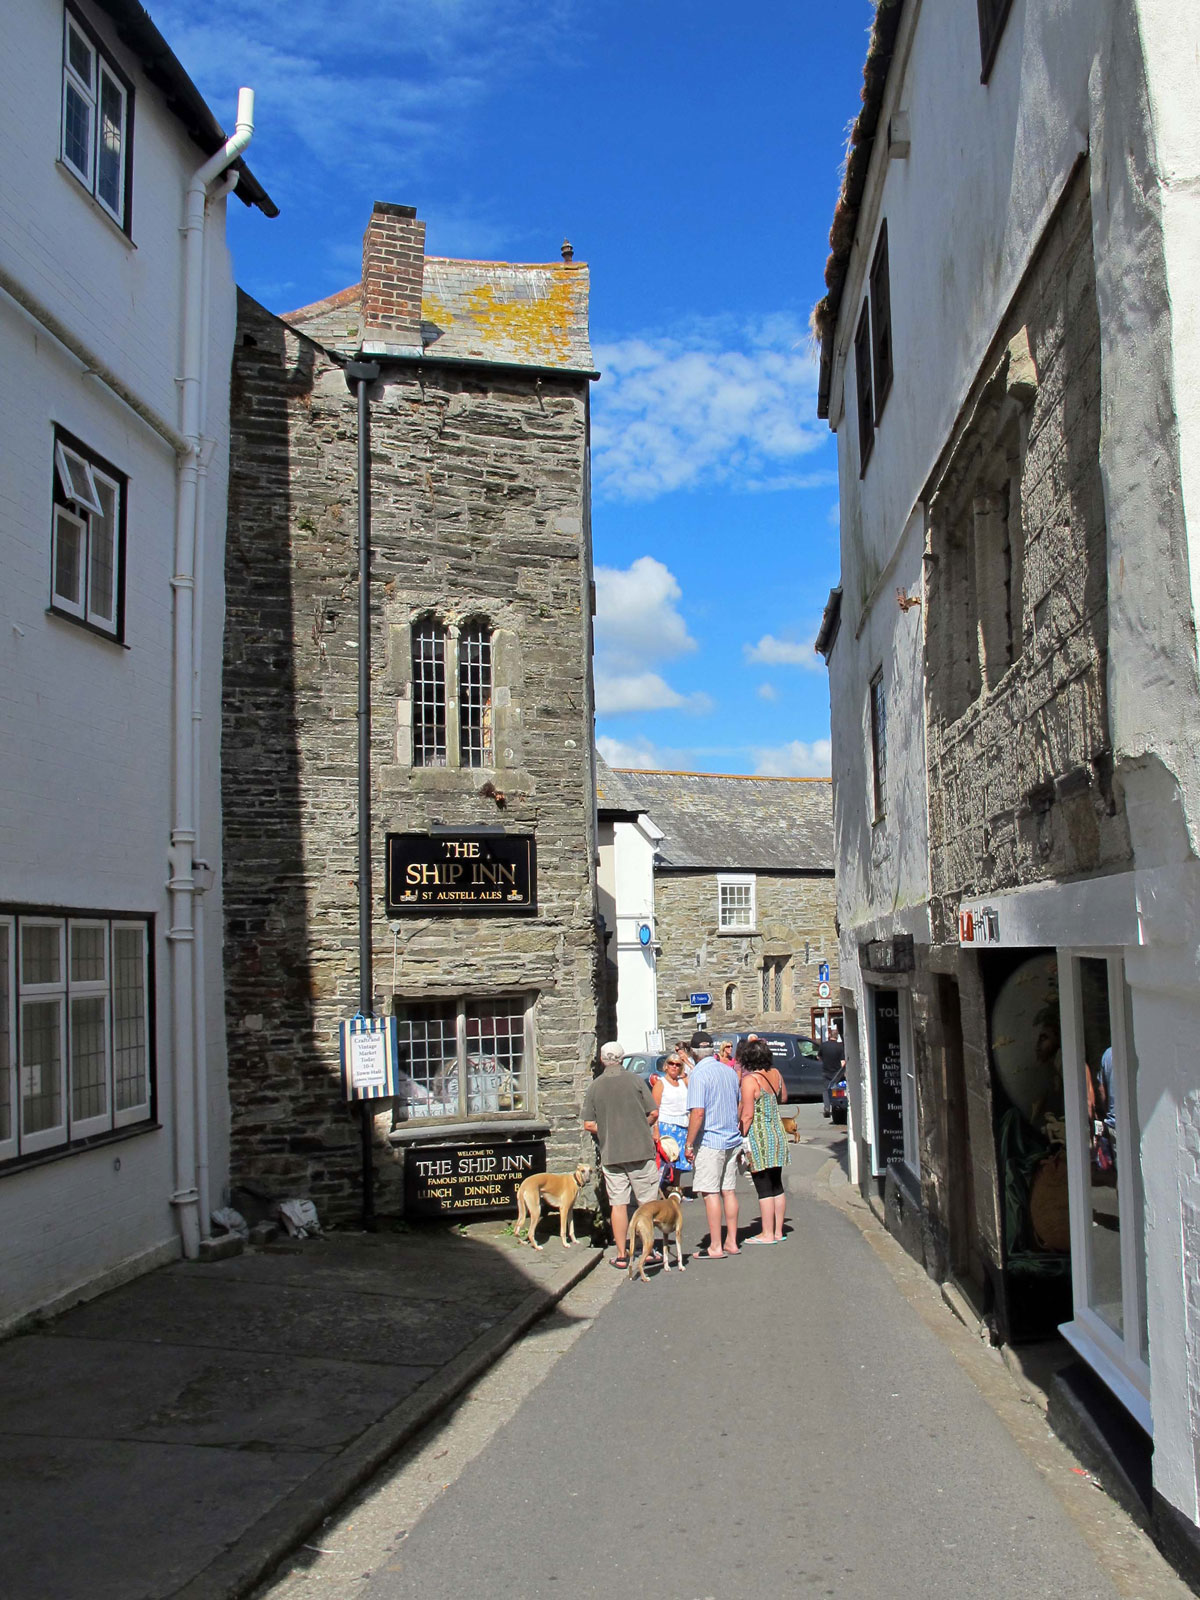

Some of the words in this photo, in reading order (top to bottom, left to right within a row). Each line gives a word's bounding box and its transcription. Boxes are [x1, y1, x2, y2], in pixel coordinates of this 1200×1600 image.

[442, 842, 481, 858] THE
[406, 863, 463, 885] SHIP
[471, 863, 516, 885] INN
[422, 891, 433, 900] ST
[437, 891, 477, 900] AUSTELL
[480, 891, 502, 900] ALES
[882, 1063, 900, 1071] Daily
[416, 1160, 453, 1176] THE
[458, 1157, 497, 1174] SHIP
[501, 1155, 533, 1171] INN
[427, 1176, 458, 1185] FAMOUS
[475, 1173, 507, 1182] CENTURY
[508, 1172, 523, 1180] PUB
[417, 1188, 452, 1199] LUNCH
[464, 1184, 502, 1196] DINNER
[454, 1198, 488, 1208] AUSTELL
[490, 1196, 510, 1205] ALES
